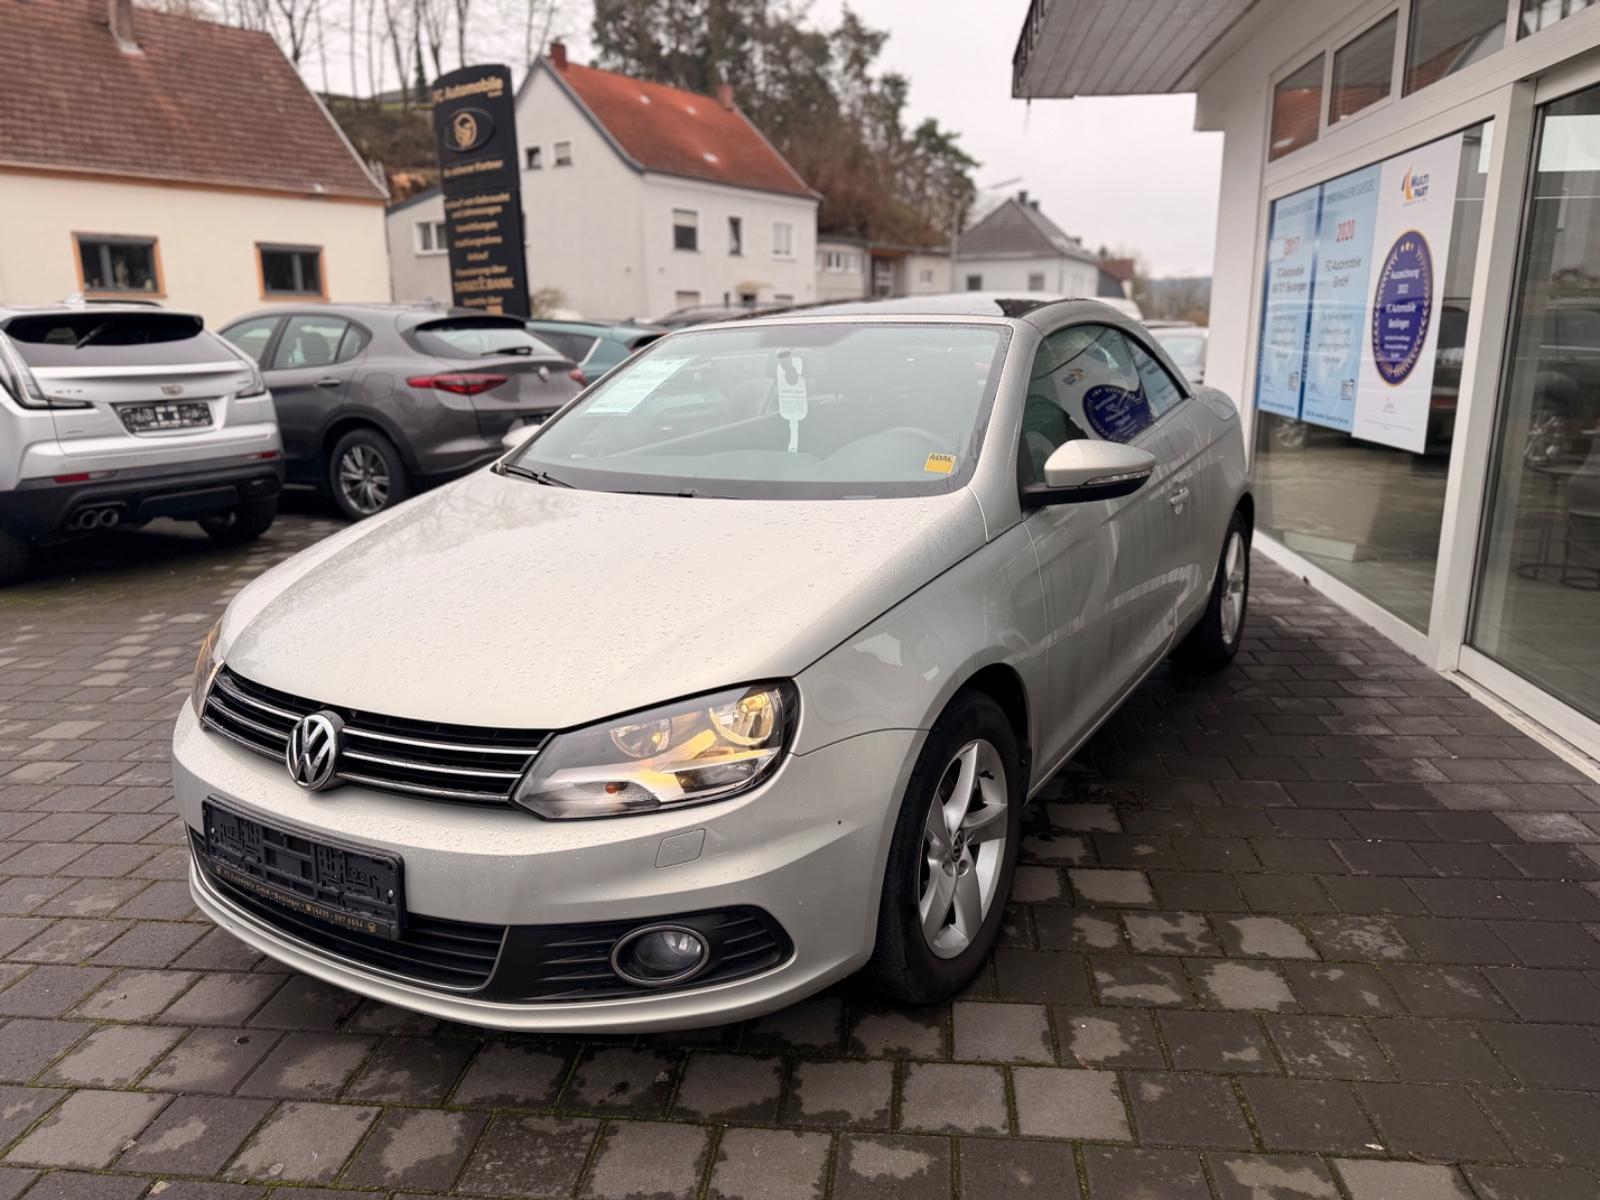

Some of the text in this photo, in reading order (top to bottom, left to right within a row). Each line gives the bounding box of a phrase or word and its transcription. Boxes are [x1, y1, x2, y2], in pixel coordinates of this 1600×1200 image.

[1411, 174, 1429, 188] MULTI
[1414, 185, 1429, 198] PART
[1336, 219, 1356, 243] 2020
